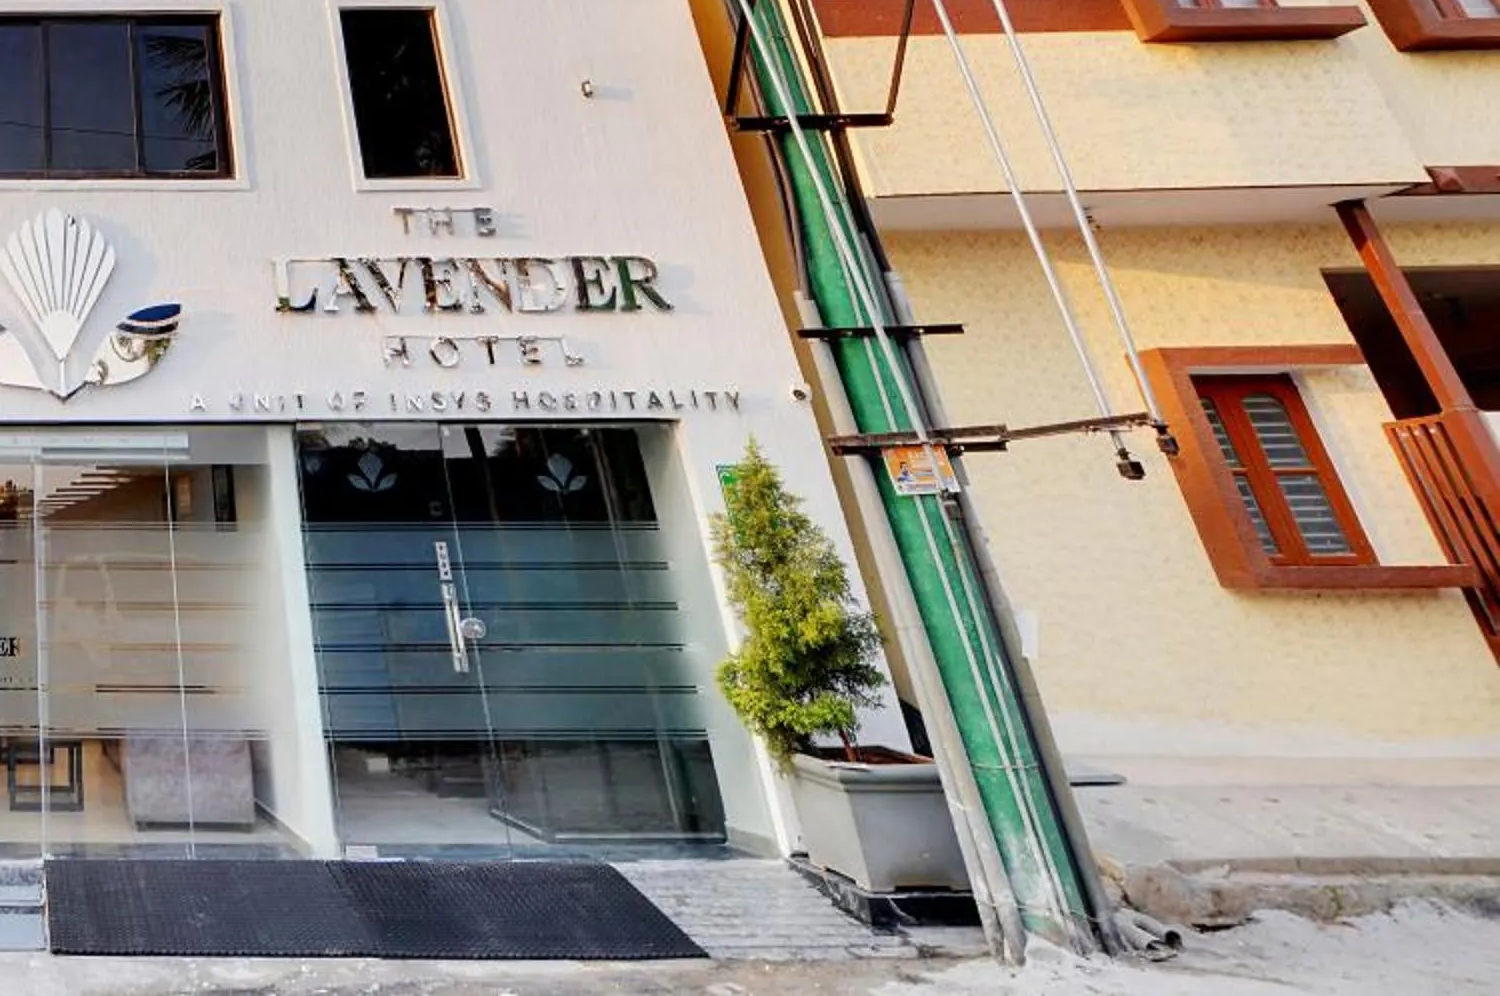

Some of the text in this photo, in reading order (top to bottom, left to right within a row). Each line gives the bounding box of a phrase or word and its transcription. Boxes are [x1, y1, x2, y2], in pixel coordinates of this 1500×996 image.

[393, 207, 497, 236] THE
[273, 255, 674, 312] LAVENDER
[384, 335, 585, 367] HOTEL
[191, 390, 740, 413] A UNIT OF INSYS HOSPITALITY
